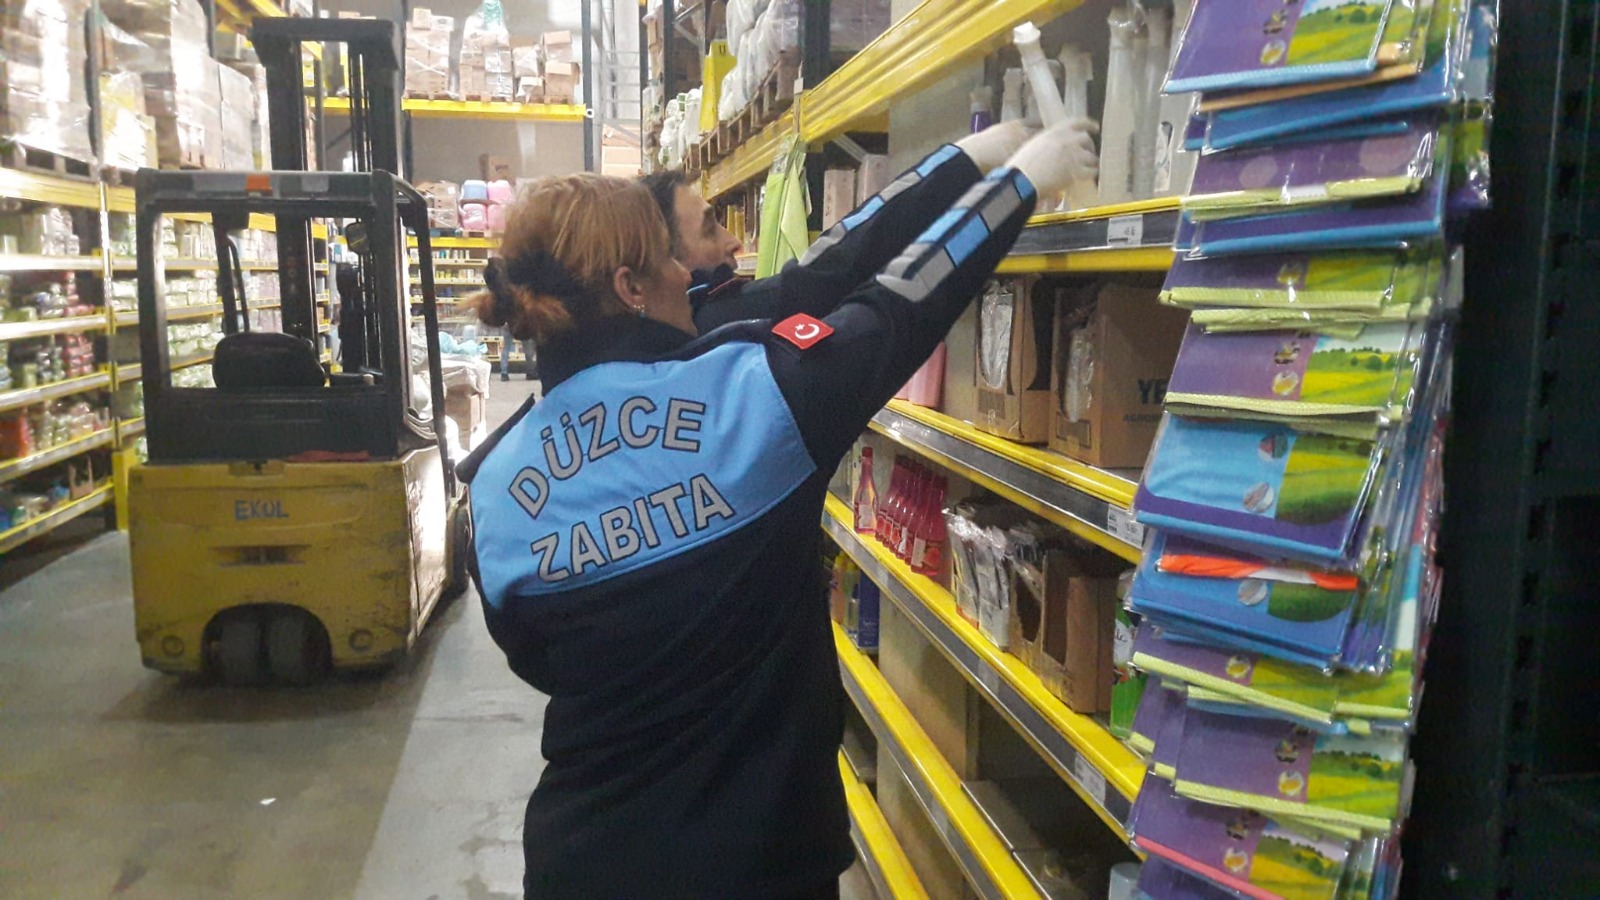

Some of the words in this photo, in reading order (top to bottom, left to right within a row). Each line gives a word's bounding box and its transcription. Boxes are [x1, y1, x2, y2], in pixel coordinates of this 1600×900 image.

[235, 499, 289, 521] EKOL
[509, 396, 706, 519] DÜZCE
[531, 473, 736, 582] ZABITA
